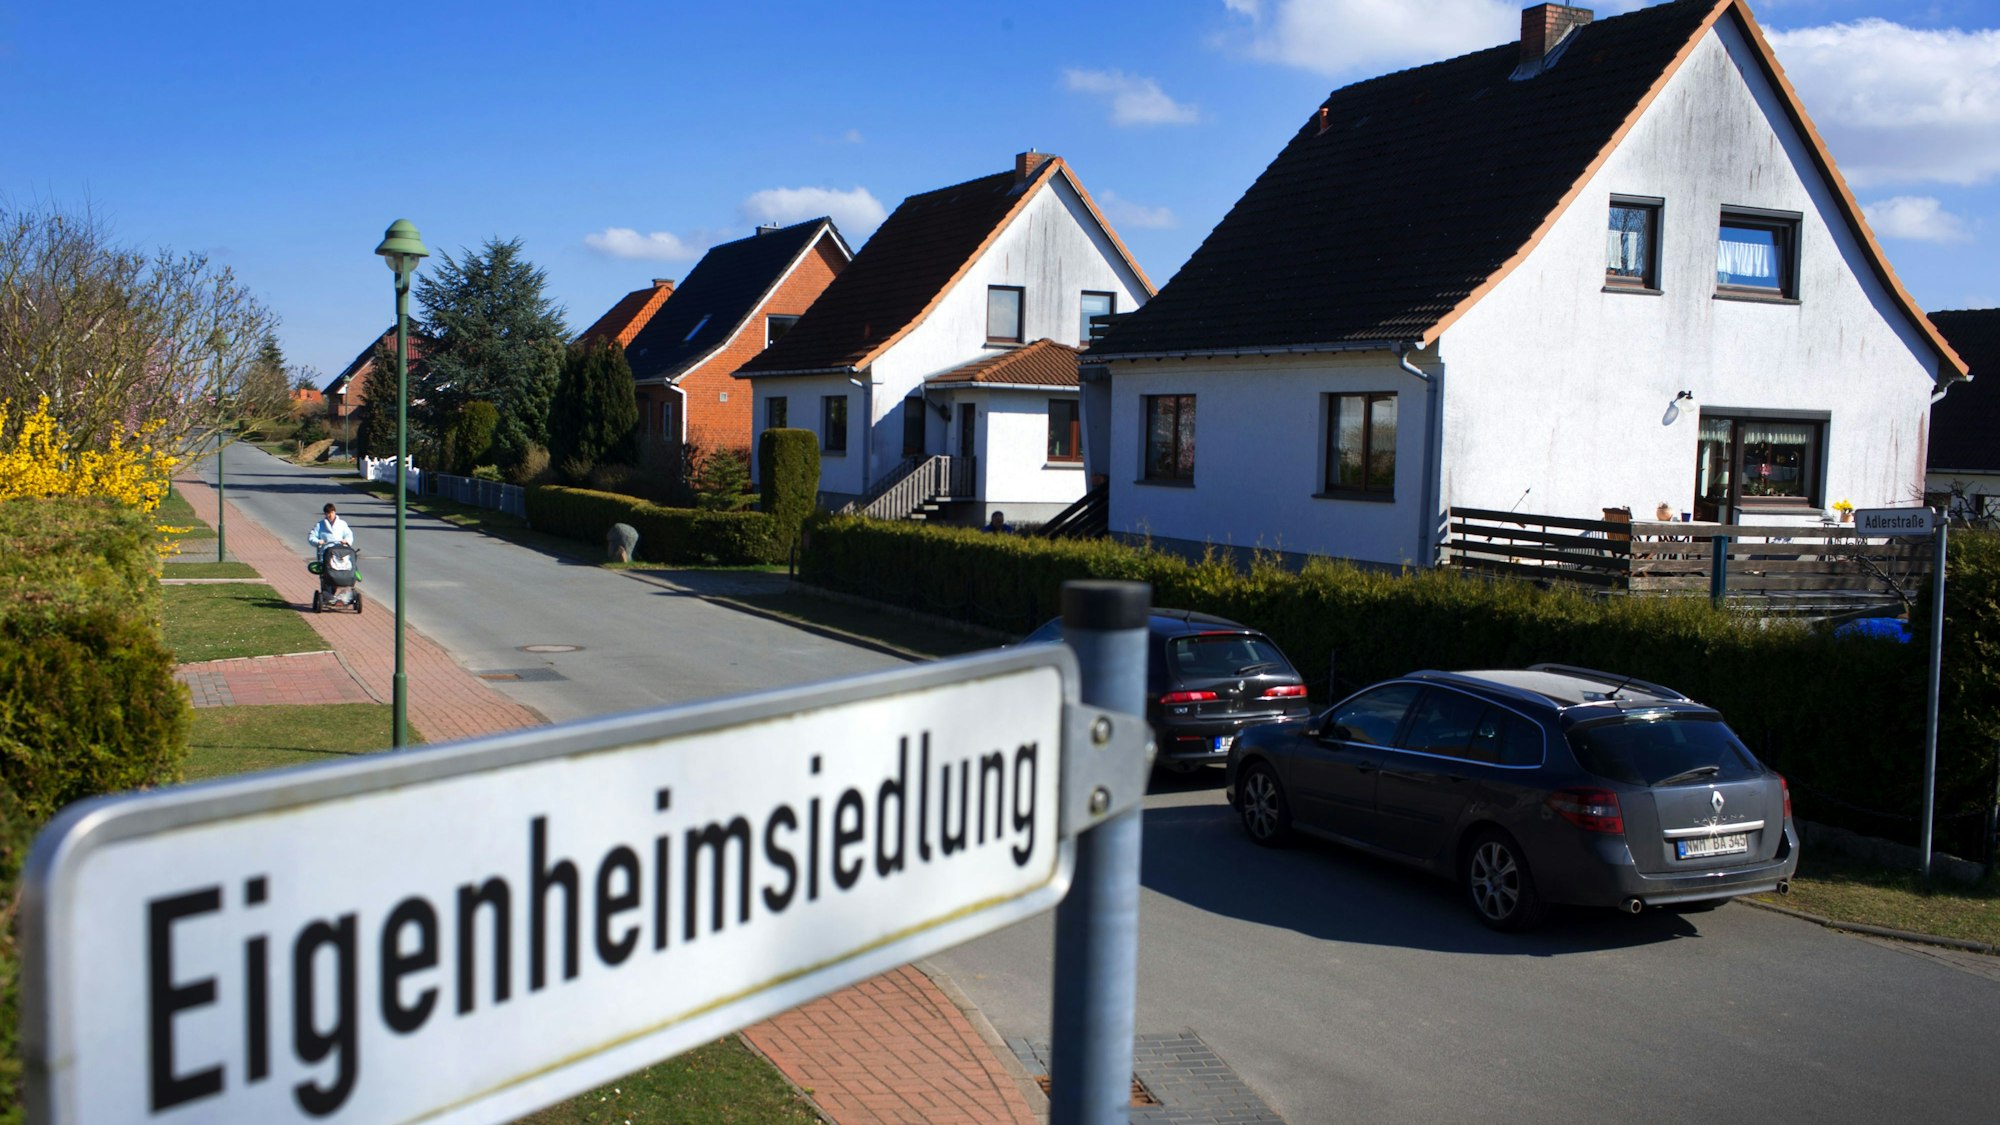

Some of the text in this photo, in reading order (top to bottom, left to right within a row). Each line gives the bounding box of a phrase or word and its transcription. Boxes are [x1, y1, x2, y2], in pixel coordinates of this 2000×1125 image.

[1865, 514, 1924, 529] Adlerstraße
[1686, 833, 1746, 853] NWM BA 345
[146, 731, 1039, 1118] Eigenheimsiedlung
